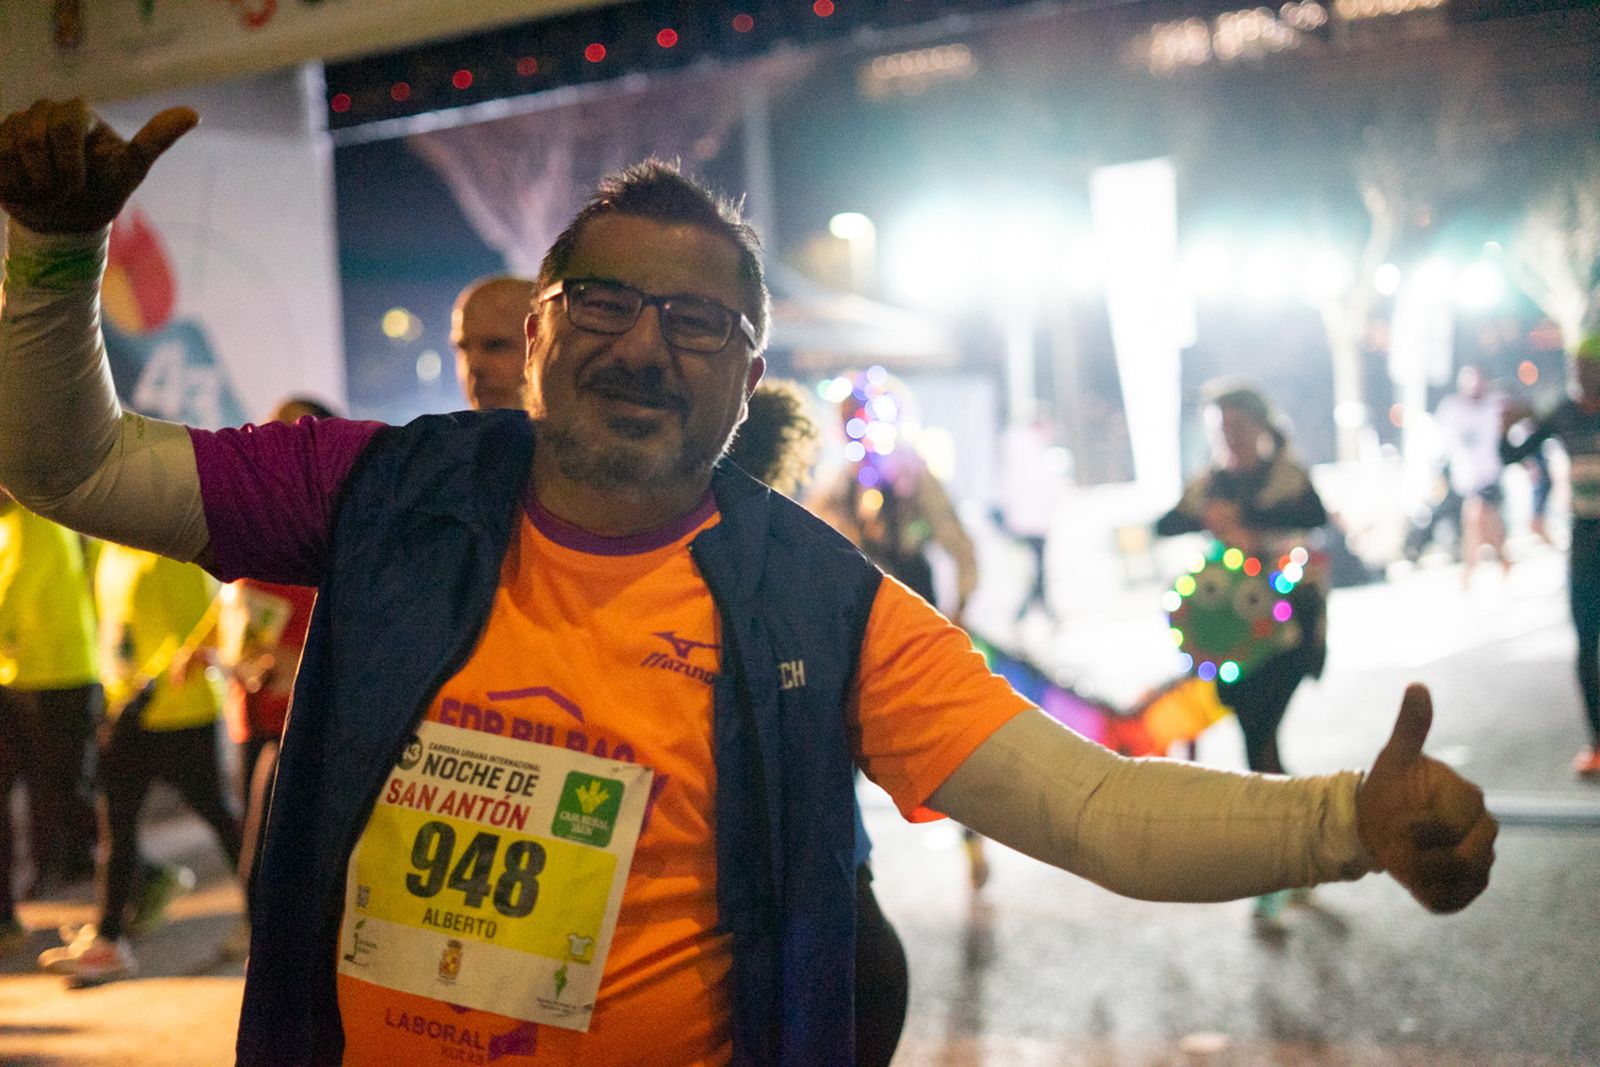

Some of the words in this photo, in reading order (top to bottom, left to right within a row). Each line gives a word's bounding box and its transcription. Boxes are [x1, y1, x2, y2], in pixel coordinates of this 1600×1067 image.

[428, 742, 460, 756] CARRERA
[461, 749, 488, 762] URBANA
[421, 752, 505, 790] NOCHE
[504, 770, 540, 797] DE
[385, 778, 437, 812] SAN
[436, 789, 531, 832] ANTÓN
[405, 820, 547, 918] 948
[421, 907, 498, 939] ALBERTO
[384, 1006, 485, 1050] LABORAL
